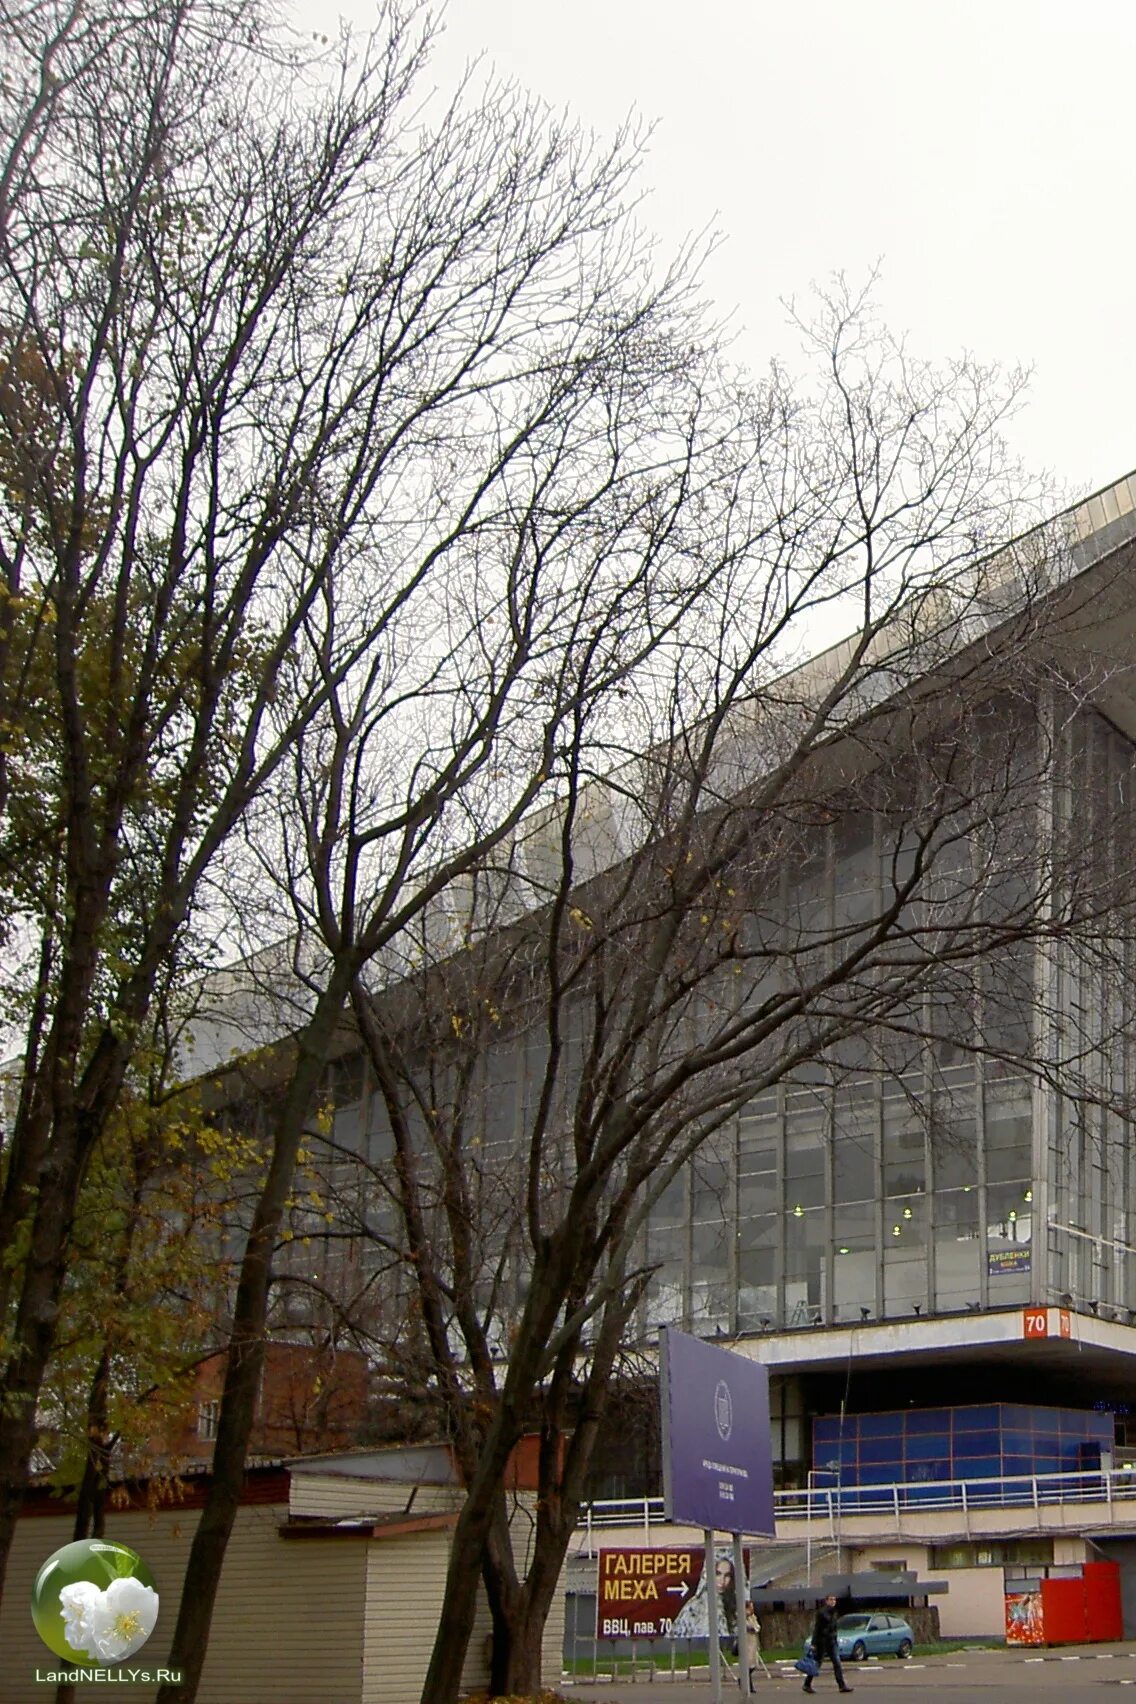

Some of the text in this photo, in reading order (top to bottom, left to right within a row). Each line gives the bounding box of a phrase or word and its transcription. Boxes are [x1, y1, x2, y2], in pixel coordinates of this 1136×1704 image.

[1026, 1315, 1045, 1332] 70
[605, 1554, 691, 1574] ГАЛЕРЕЯ
[604, 1579, 659, 1600] МЕХА
[603, 1618, 672, 1636] ВВЦ, пав. 70
